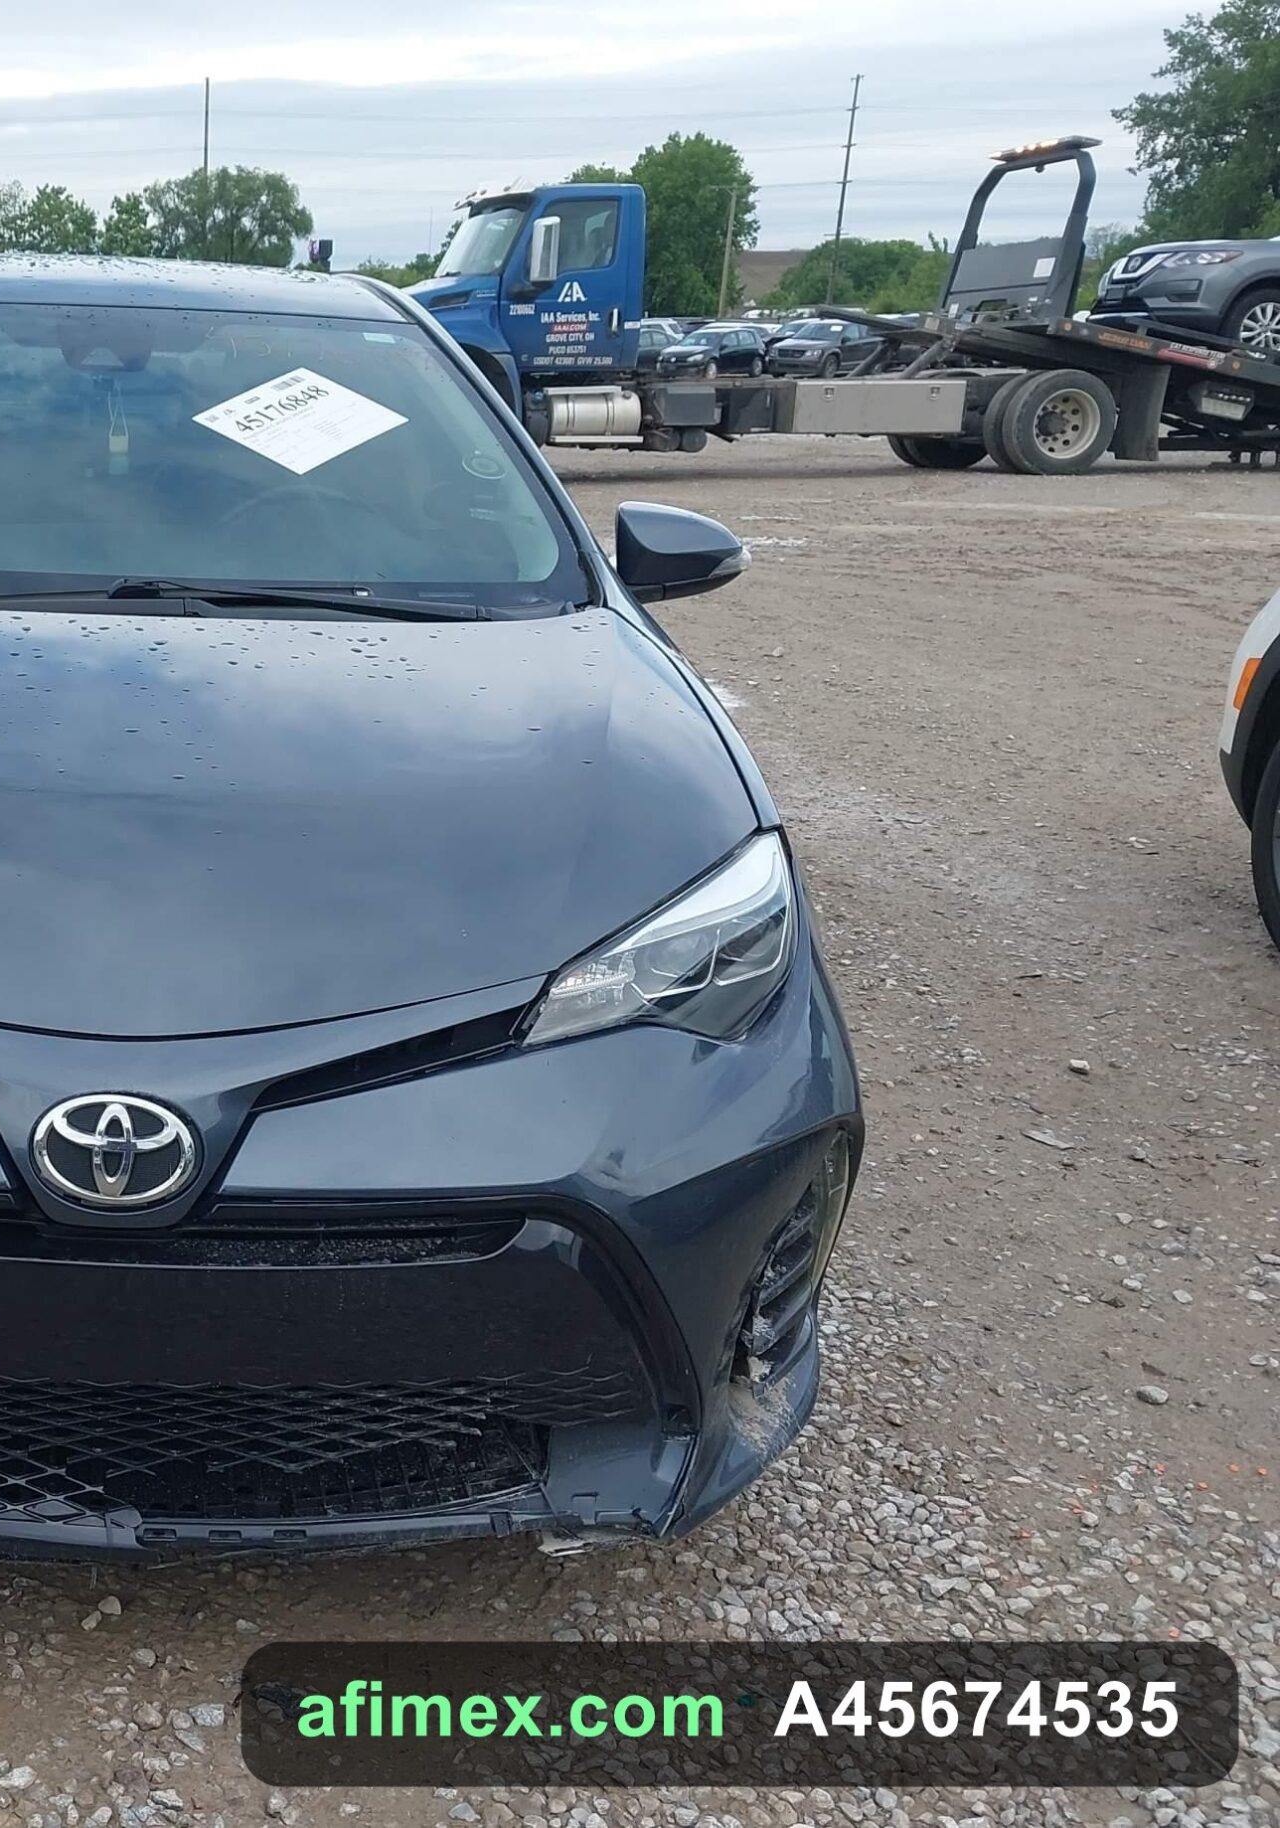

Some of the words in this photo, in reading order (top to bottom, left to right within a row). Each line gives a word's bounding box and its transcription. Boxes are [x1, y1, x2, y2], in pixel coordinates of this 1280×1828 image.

[540, 312, 555, 323] IAA
[556, 311, 587, 323] Services,
[588, 310, 601, 322] Inc.
[546, 333, 568, 343] GROVE
[585, 332, 595, 341] OH
[234, 384, 330, 434] 45176848
